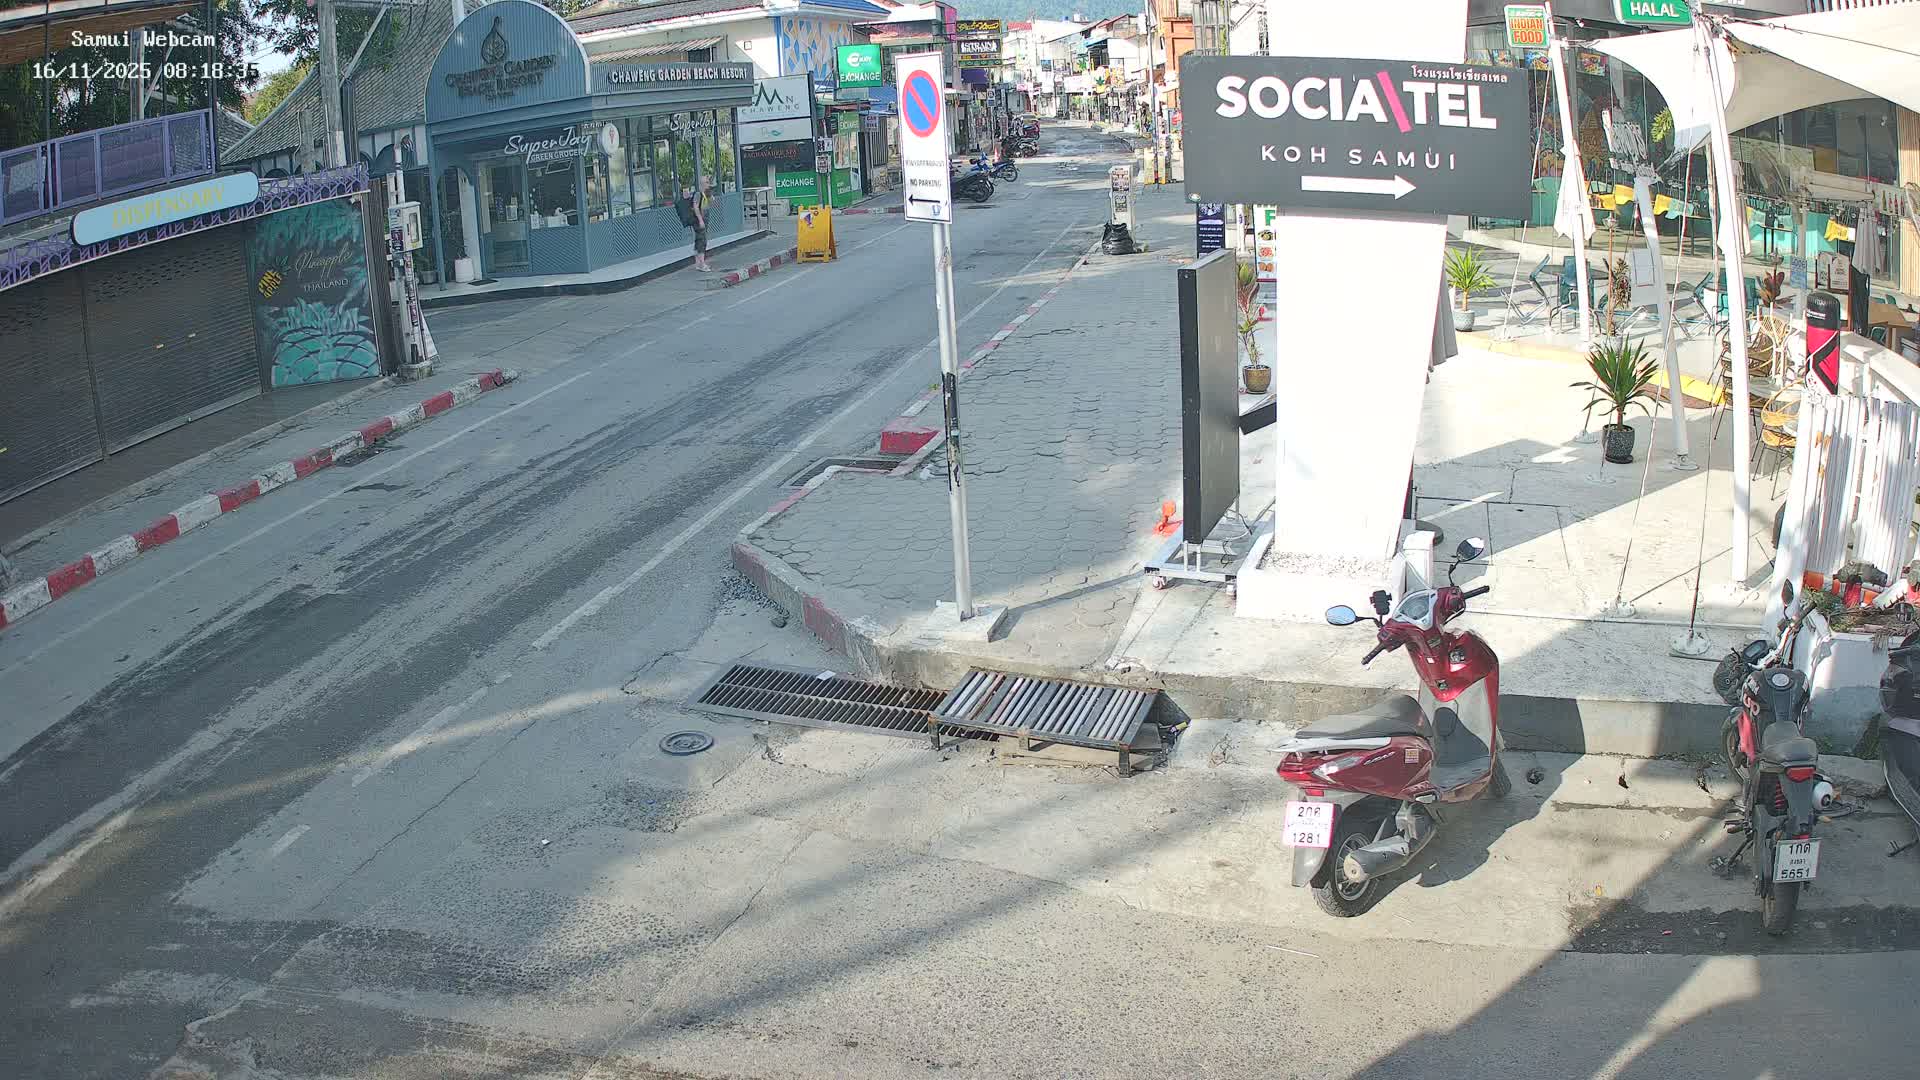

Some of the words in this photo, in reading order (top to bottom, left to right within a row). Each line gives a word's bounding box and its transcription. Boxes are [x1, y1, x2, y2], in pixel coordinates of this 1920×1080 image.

[1630, 1, 1679, 17] HALAL
[1510, 17, 1544, 30] INDIAN
[1513, 30, 1544, 43] FOOD
[612, 70, 656, 83] CHAWENG
[658, 68, 691, 81] GARDEN
[693, 68, 719, 80] BEACH
[721, 67, 747, 79] RESORT
[840, 72, 881, 82] EXCHANGE
[741, 104, 800, 114] CHAWENG
[1261, 145, 1326, 164] KOH
[1349, 148, 1456, 170] SAMUI
[776, 177, 814, 188] EXCHANGE
[910, 178, 918, 186] NO
[919, 178, 942, 187] PARKING
[112, 183, 224, 229] DISPENSARY
[295, 242, 353, 281] Pineapple
[303, 277, 349, 292] THAILAND
[1293, 832, 1320, 844] 1281
[1781, 868, 1811, 879] 5651
